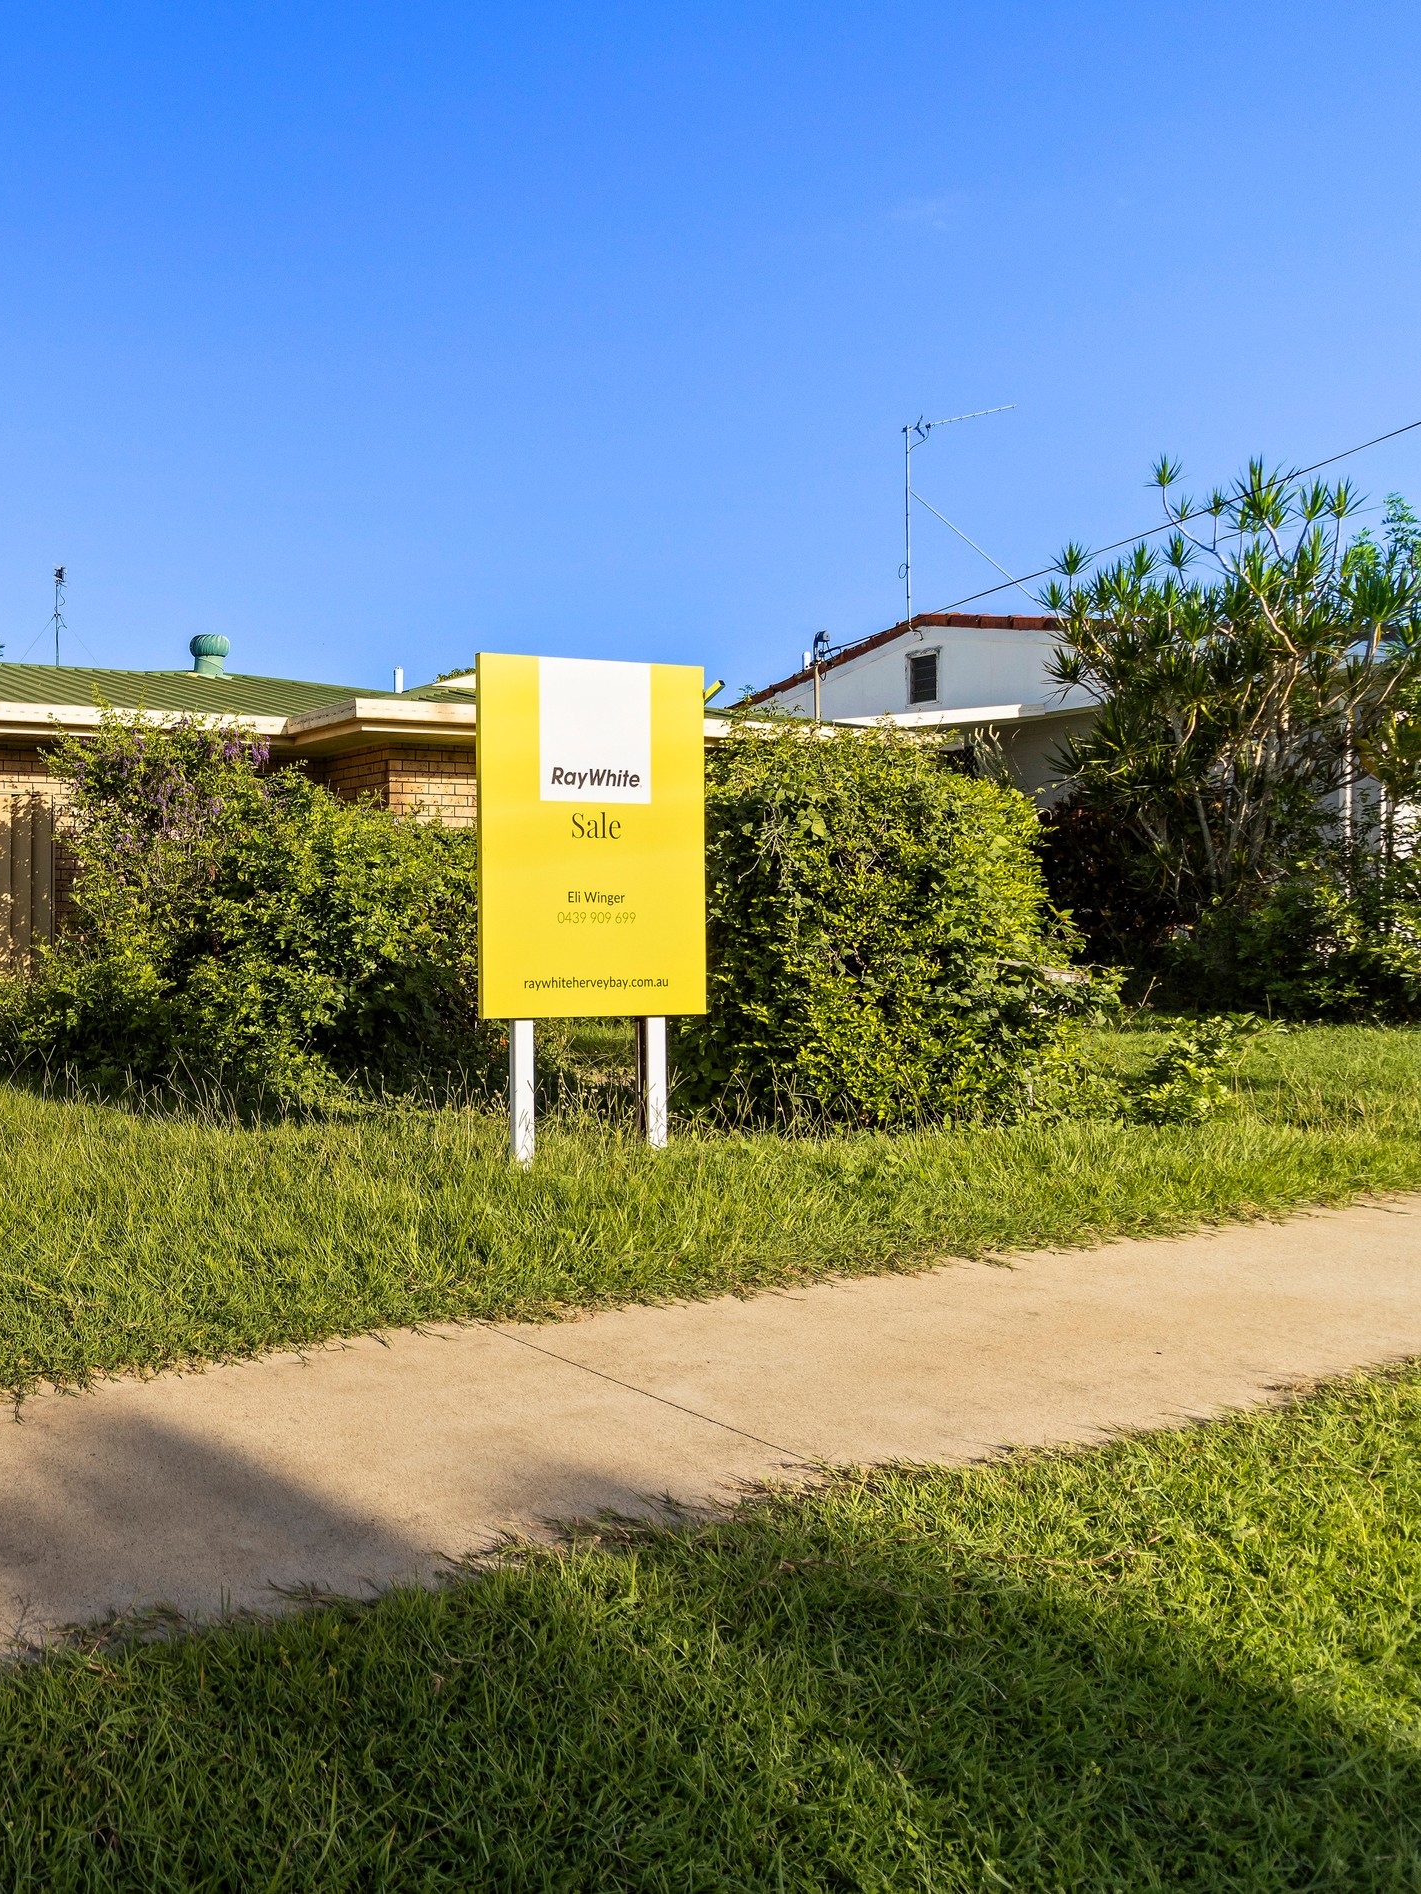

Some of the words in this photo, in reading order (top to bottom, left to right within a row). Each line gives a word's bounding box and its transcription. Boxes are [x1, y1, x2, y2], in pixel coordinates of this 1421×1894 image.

[551, 767, 641, 790] RayWhite
[571, 812, 622, 840] Sale
[567, 891, 581, 904] Eli
[584, 891, 626, 907] Winger
[557, 911, 587, 924] 0439
[590, 911, 612, 924] 909
[615, 911, 637, 925] 699
[523, 976, 669, 991] raywhiteherveybay.com.au
